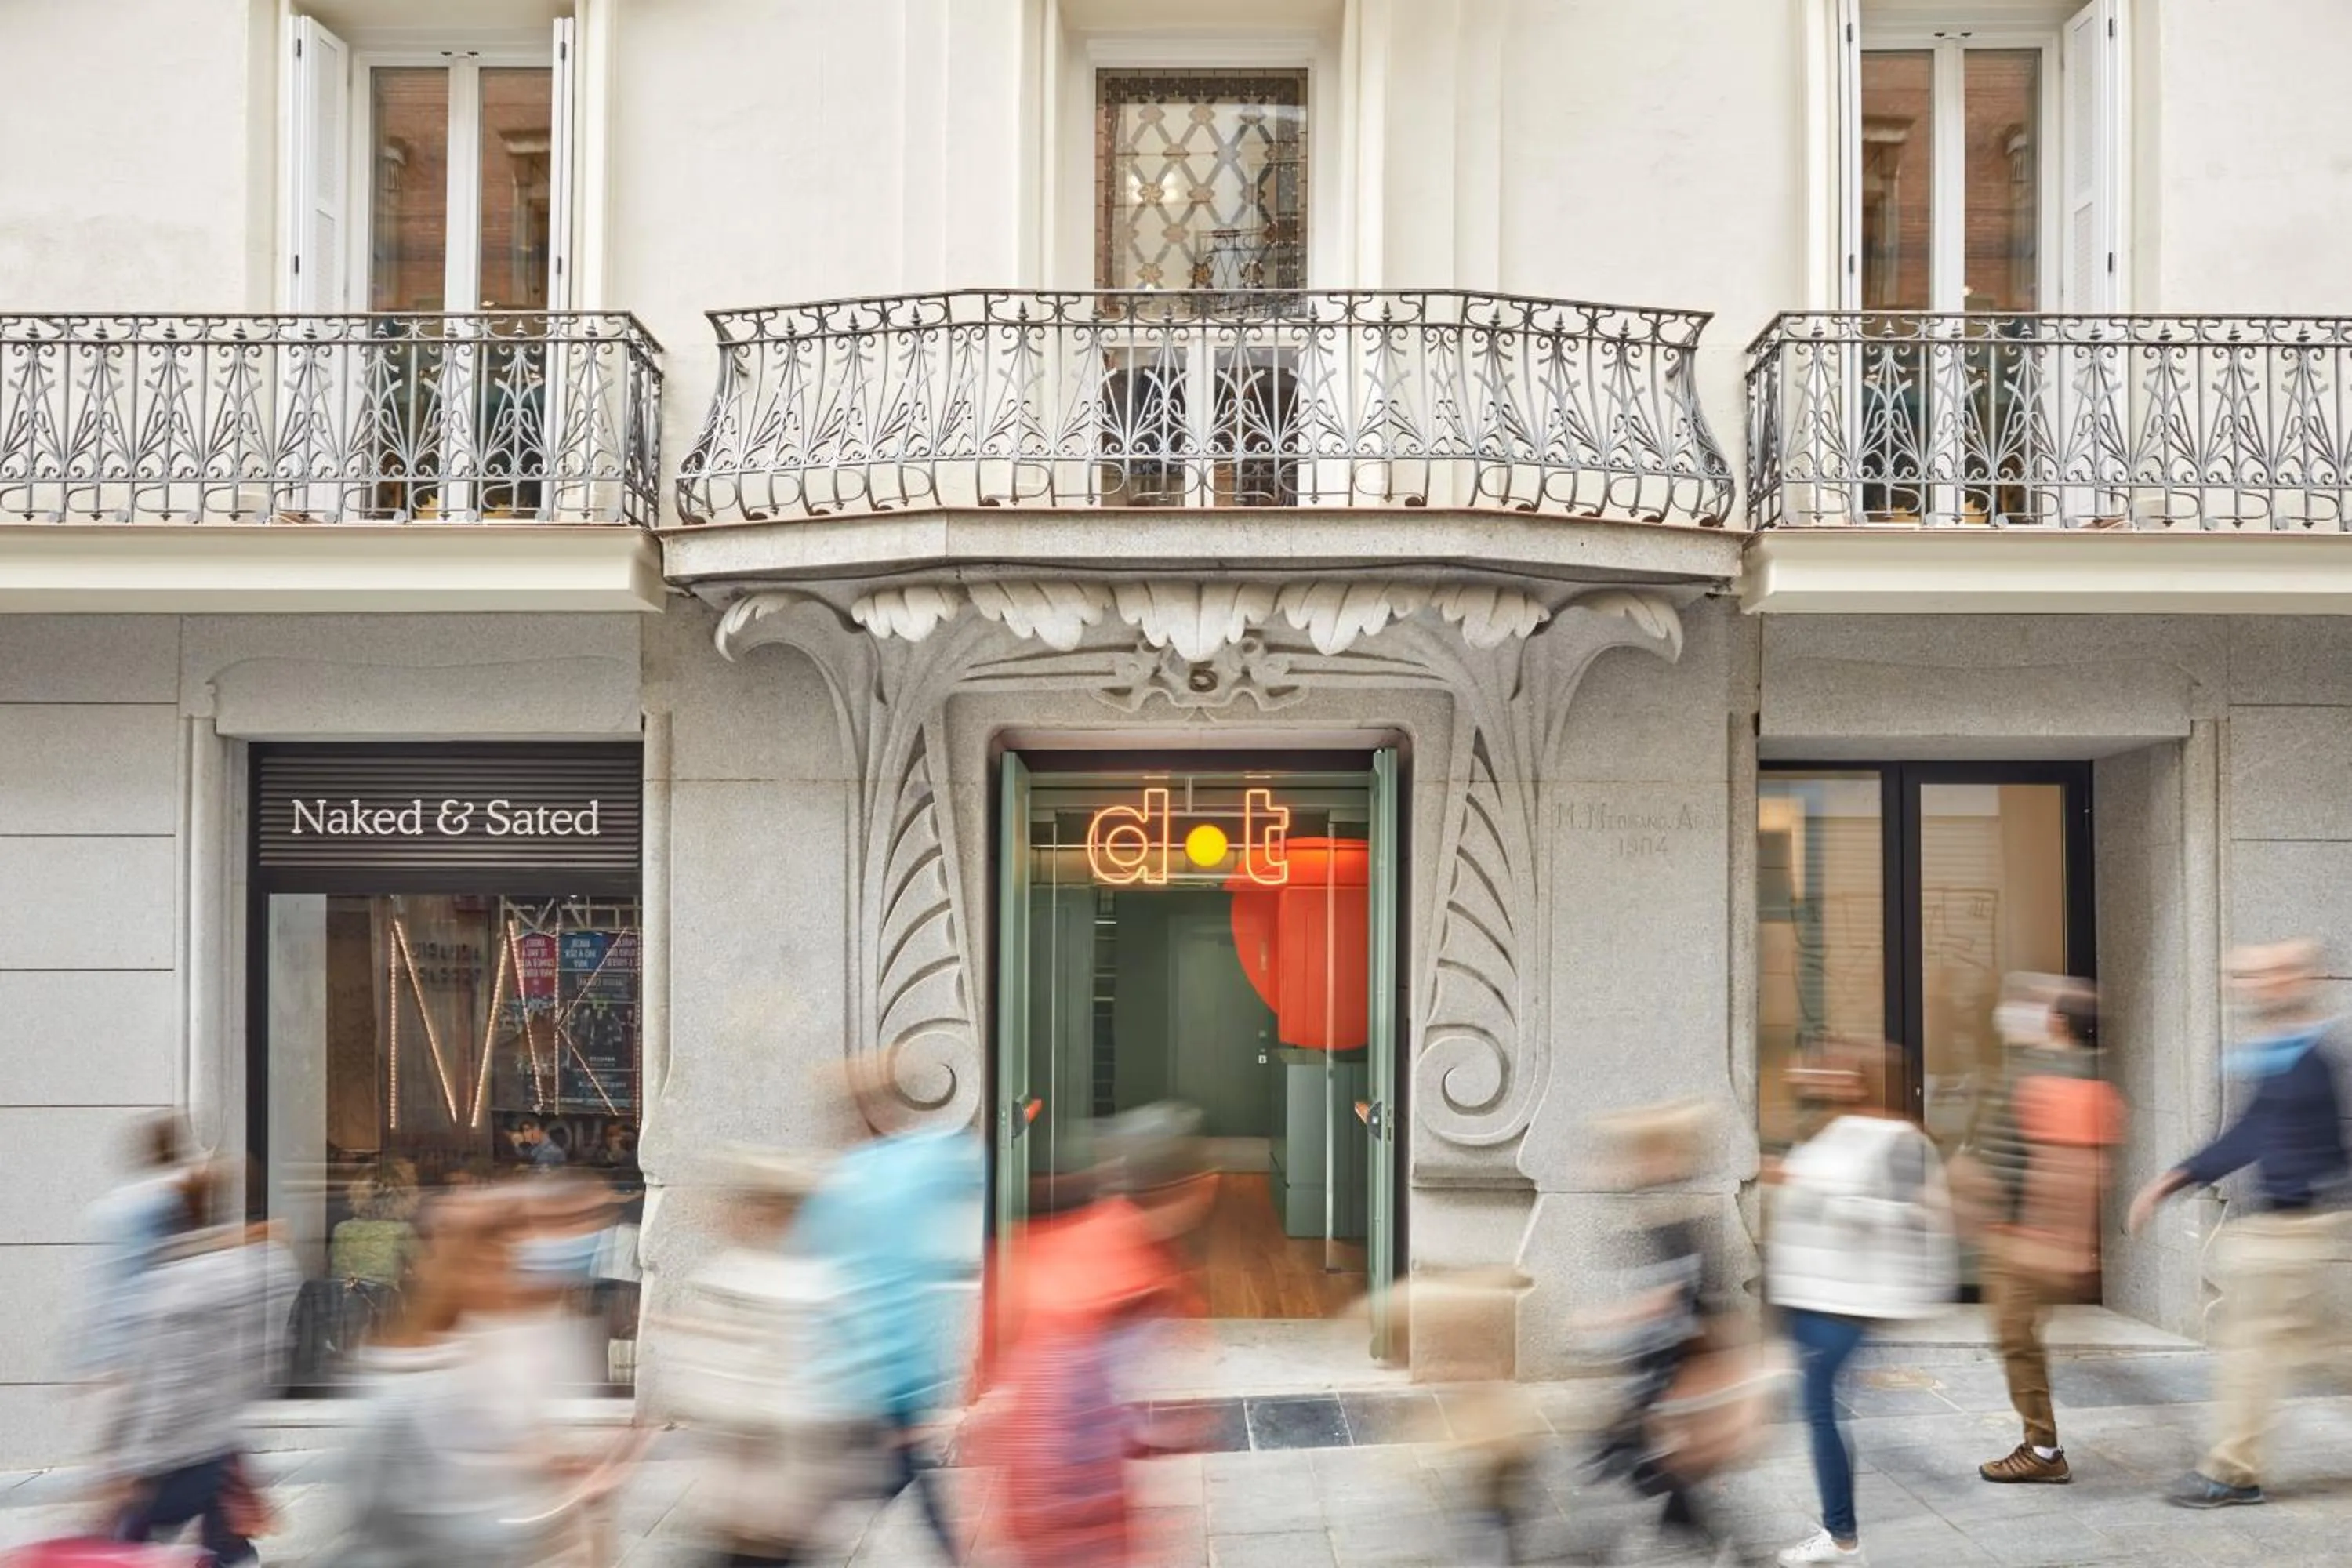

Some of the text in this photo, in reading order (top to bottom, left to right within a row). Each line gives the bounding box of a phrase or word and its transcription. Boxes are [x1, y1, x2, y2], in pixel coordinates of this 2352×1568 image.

[291, 799, 601, 835] Naked & Sated
